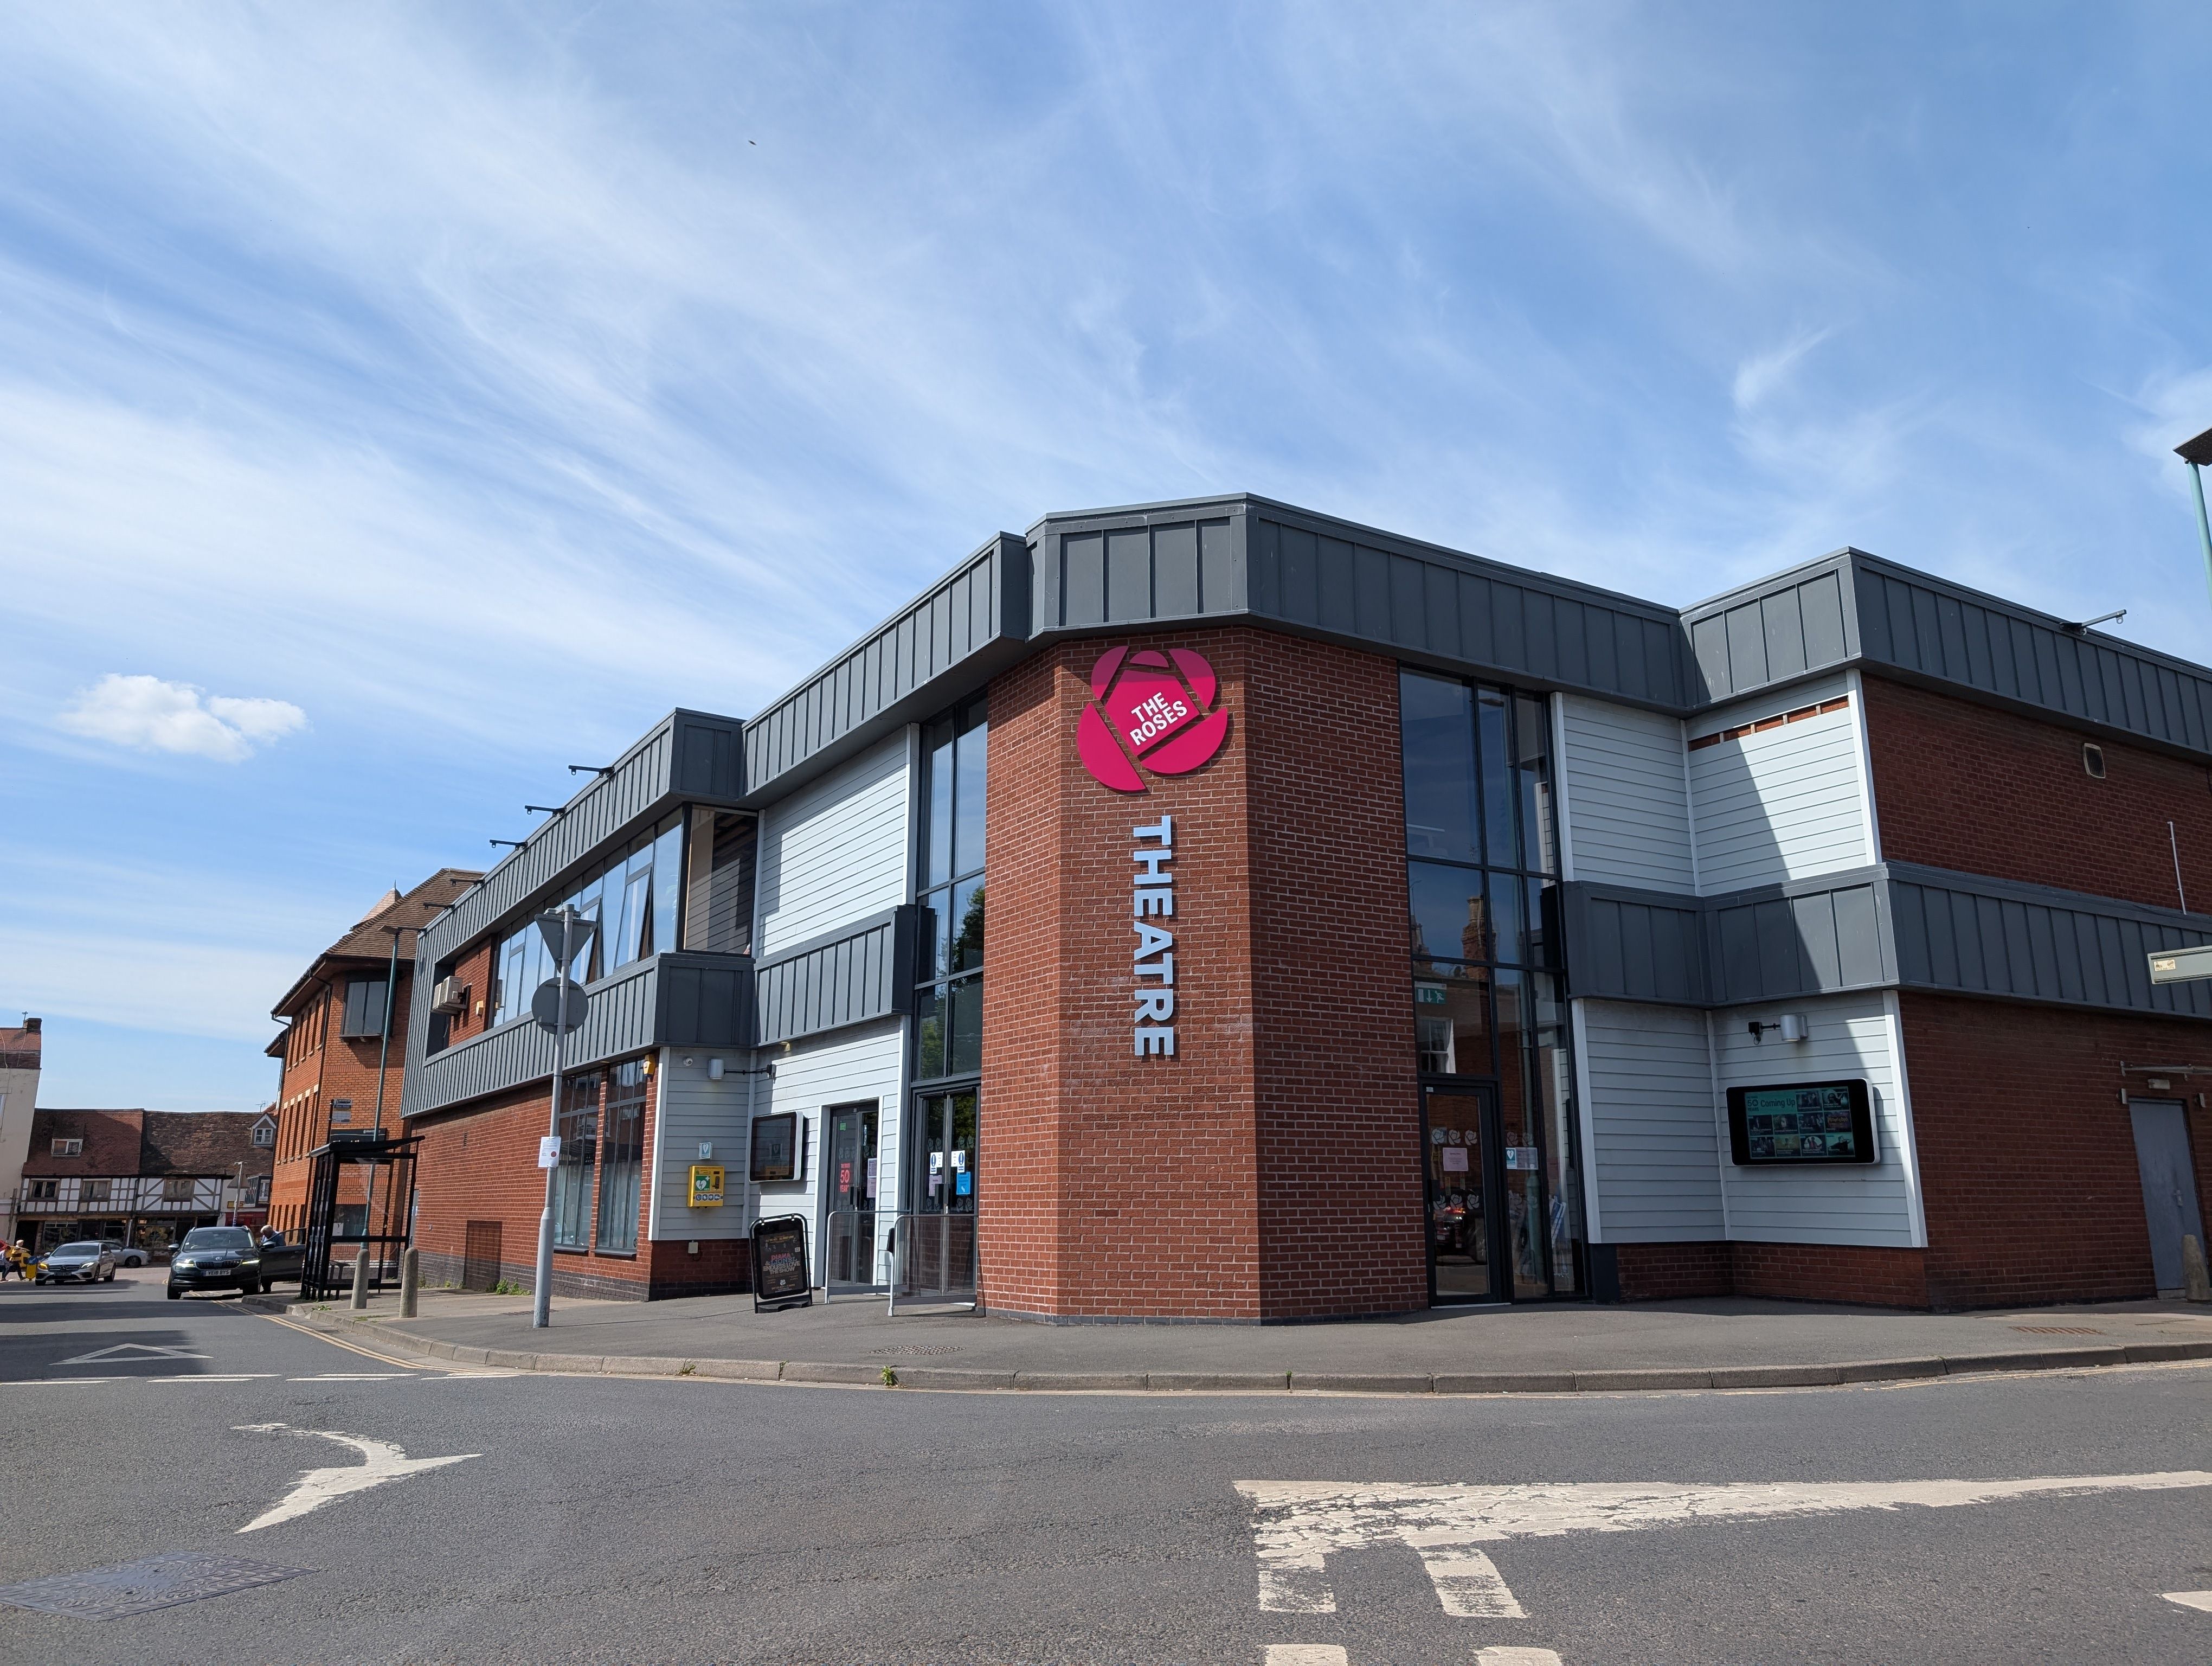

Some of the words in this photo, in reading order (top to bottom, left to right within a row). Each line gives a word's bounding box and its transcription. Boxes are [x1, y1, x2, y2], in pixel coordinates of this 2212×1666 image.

[1131, 693, 1168, 722] THE
[1129, 701, 1187, 746] ROSES
[1133, 815, 1174, 1056] THEATRE
[1760, 1099, 1785, 1108] Coming
[1786, 1098, 1796, 1107] Up
[840, 1169, 850, 1183] 50
[770, 1257, 798, 1265] LIONEL
